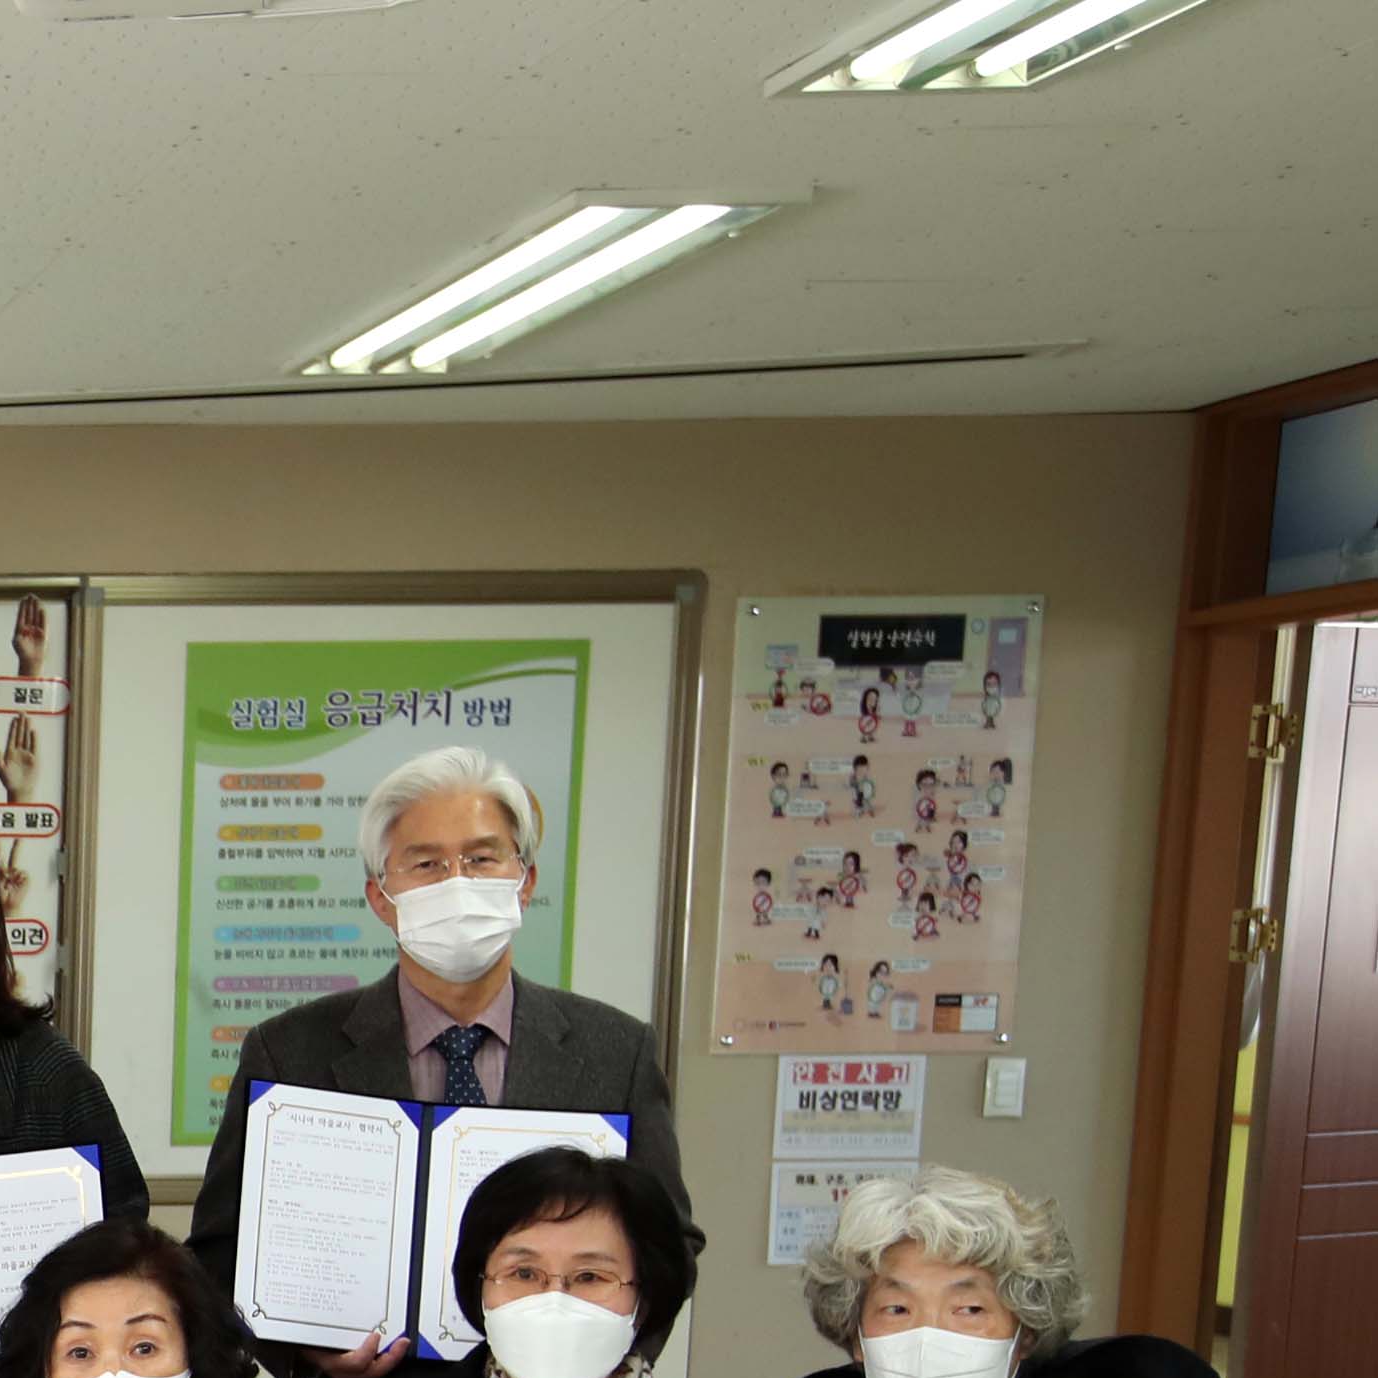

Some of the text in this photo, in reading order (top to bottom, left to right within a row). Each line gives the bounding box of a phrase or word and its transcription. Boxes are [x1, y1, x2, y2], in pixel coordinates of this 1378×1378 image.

[14, 687, 43, 704] 질문
[228, 689, 514, 729] 실험실 응급처치 방법
[25, 811, 54, 828] 발표
[11, 927, 44, 945] 의견
[798, 1089, 902, 1112] 비상연락망
